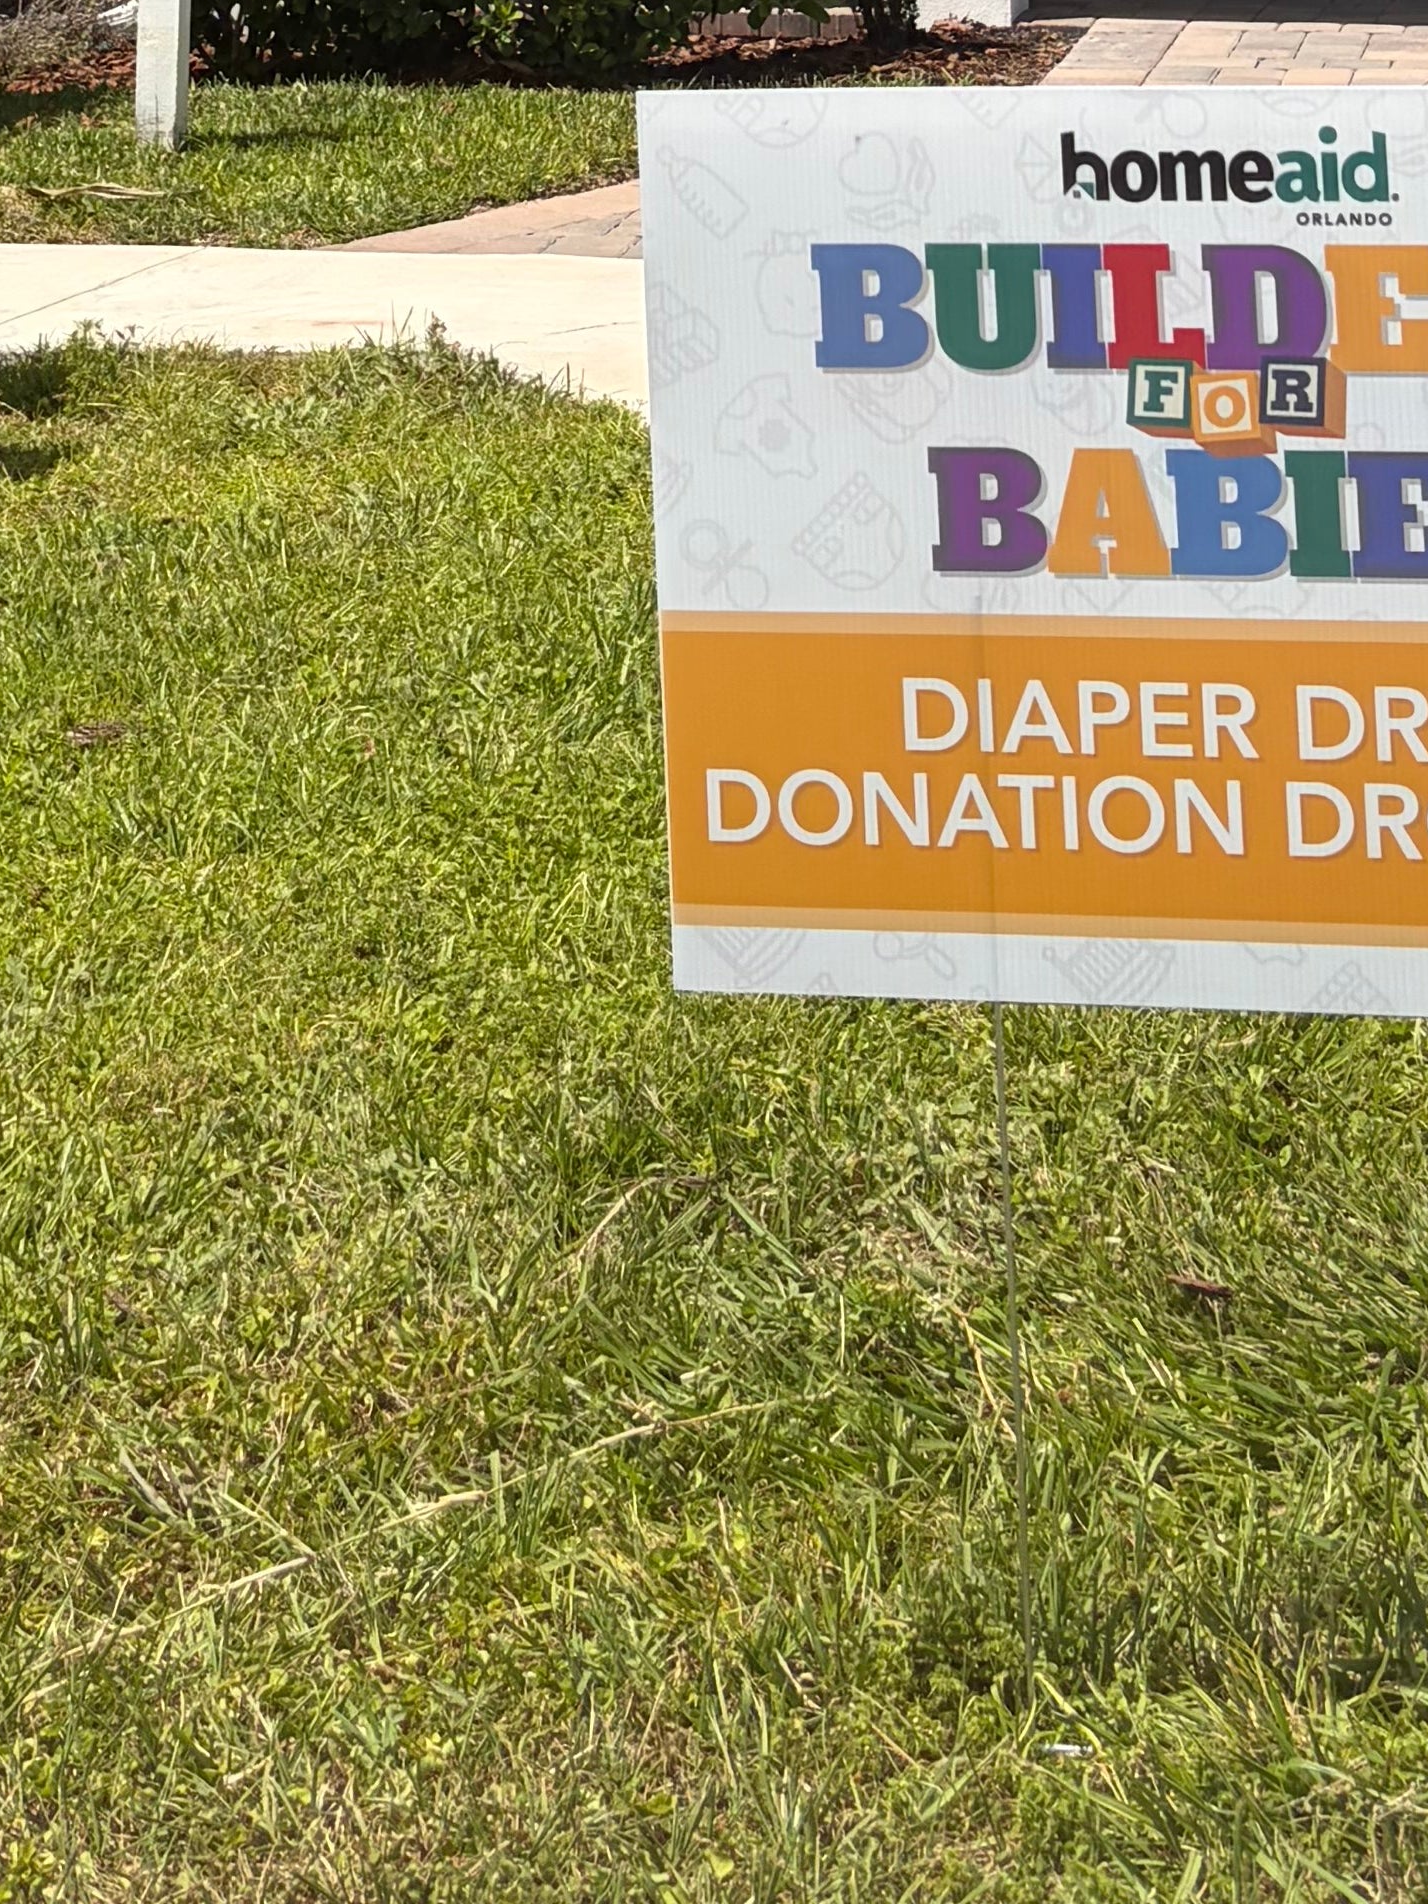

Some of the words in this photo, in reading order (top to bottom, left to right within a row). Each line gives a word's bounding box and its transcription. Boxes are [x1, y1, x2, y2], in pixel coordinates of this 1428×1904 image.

[1296, 212, 1392, 227] ORLANDO
[1143, 369, 1314, 428] FOR
[901, 677, 1259, 760] DIAPER
[705, 767, 1245, 857] DONATION
